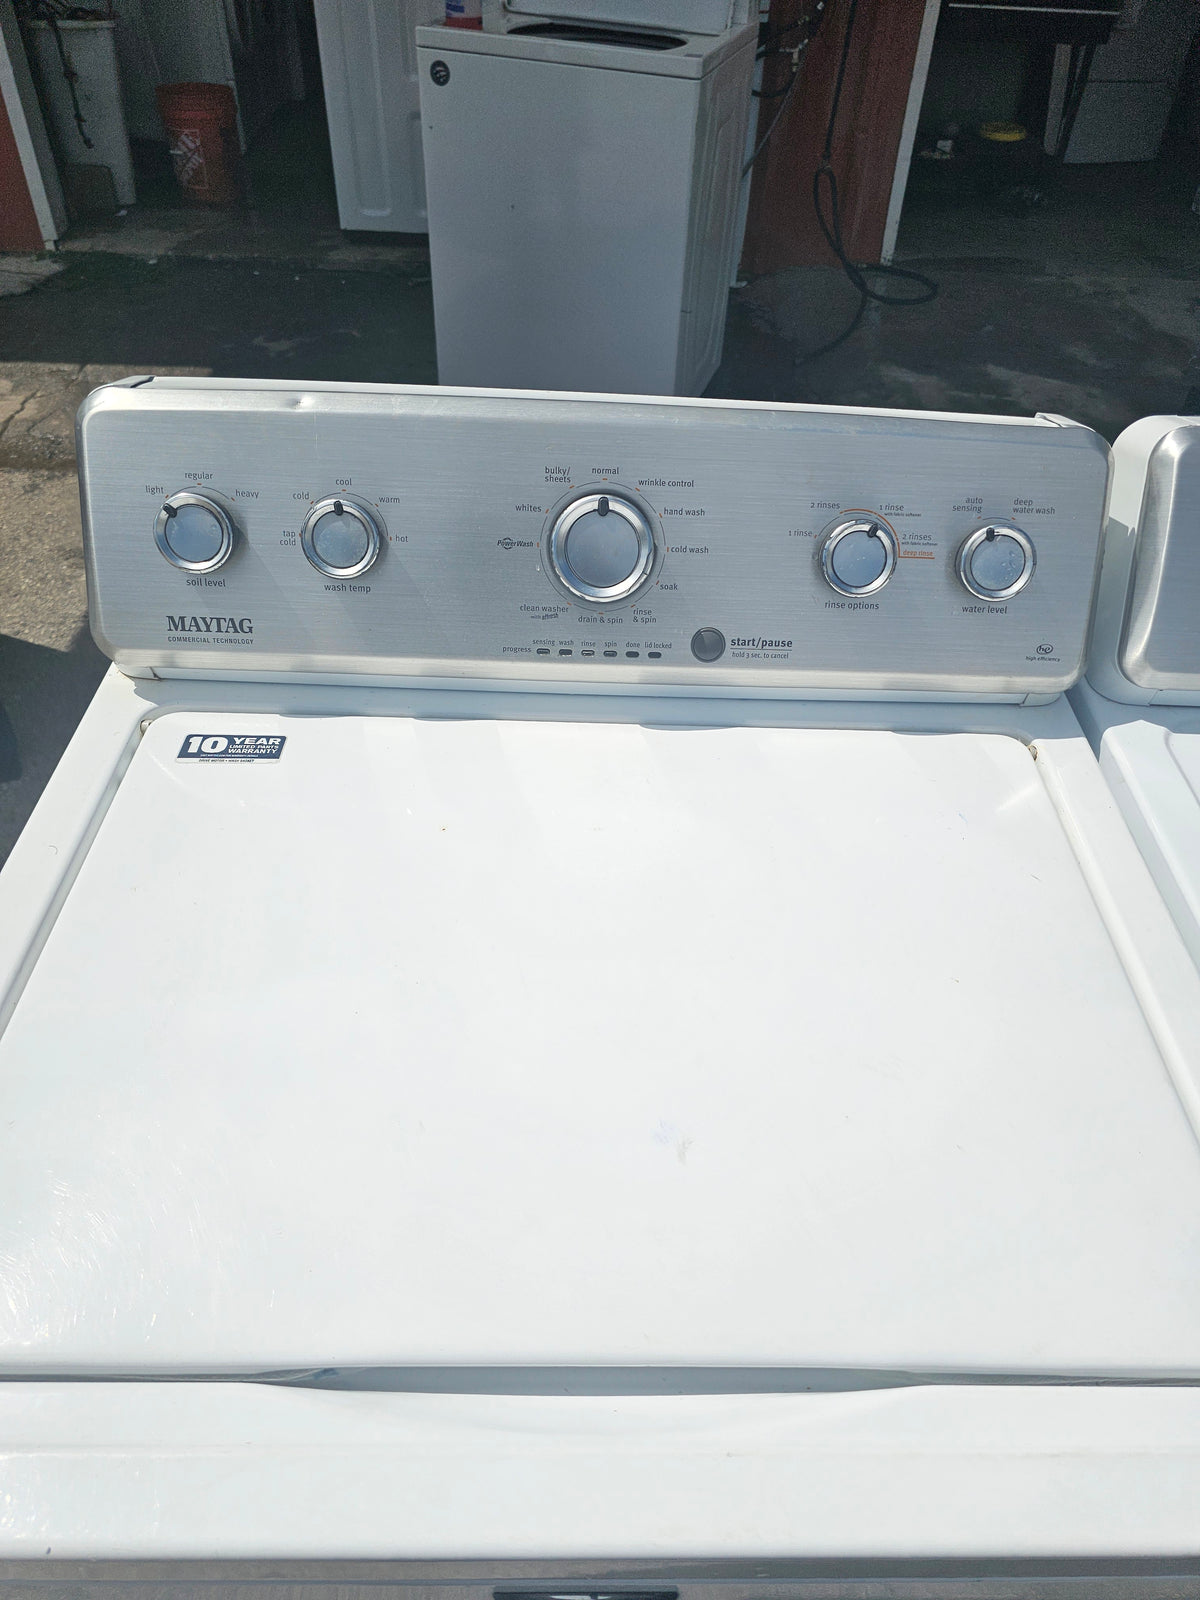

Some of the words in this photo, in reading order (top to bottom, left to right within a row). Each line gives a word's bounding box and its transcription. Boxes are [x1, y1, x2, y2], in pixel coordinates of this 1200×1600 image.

[544, 466, 571, 476] bulky/
[592, 466, 619, 474] normal
[184, 472, 213, 480] regular
[544, 475, 571, 483] sheets
[335, 478, 352, 486] cool
[668, 480, 694, 488] control
[145, 485, 164, 495] light
[235, 489, 259, 498] heavy
[293, 492, 310, 500] cold
[817, 501, 840, 510] rinses
[1014, 498, 1033, 506] deep
[664, 508, 683, 516] hand
[684, 508, 705, 516] wash
[952, 504, 982, 513] sensing
[283, 530, 296, 539] tap
[794, 529, 812, 537] rinse
[279, 538, 296, 546] cold
[395, 534, 408, 542] hot
[186, 578, 202, 587] soil
[204, 578, 226, 587] level
[660, 582, 678, 590] soak
[324, 583, 346, 592] wash
[349, 584, 371, 594] temp
[825, 600, 845, 609] rinse
[848, 601, 879, 610] options
[988, 605, 1007, 614] level
[633, 608, 652, 616] rinse
[578, 615, 598, 623] drain
[607, 616, 623, 625] spin
[641, 615, 656, 624] spin
[166, 616, 254, 634] MAYTAG
[731, 637, 792, 649] start/pause
[188, 737, 228, 753] 10
